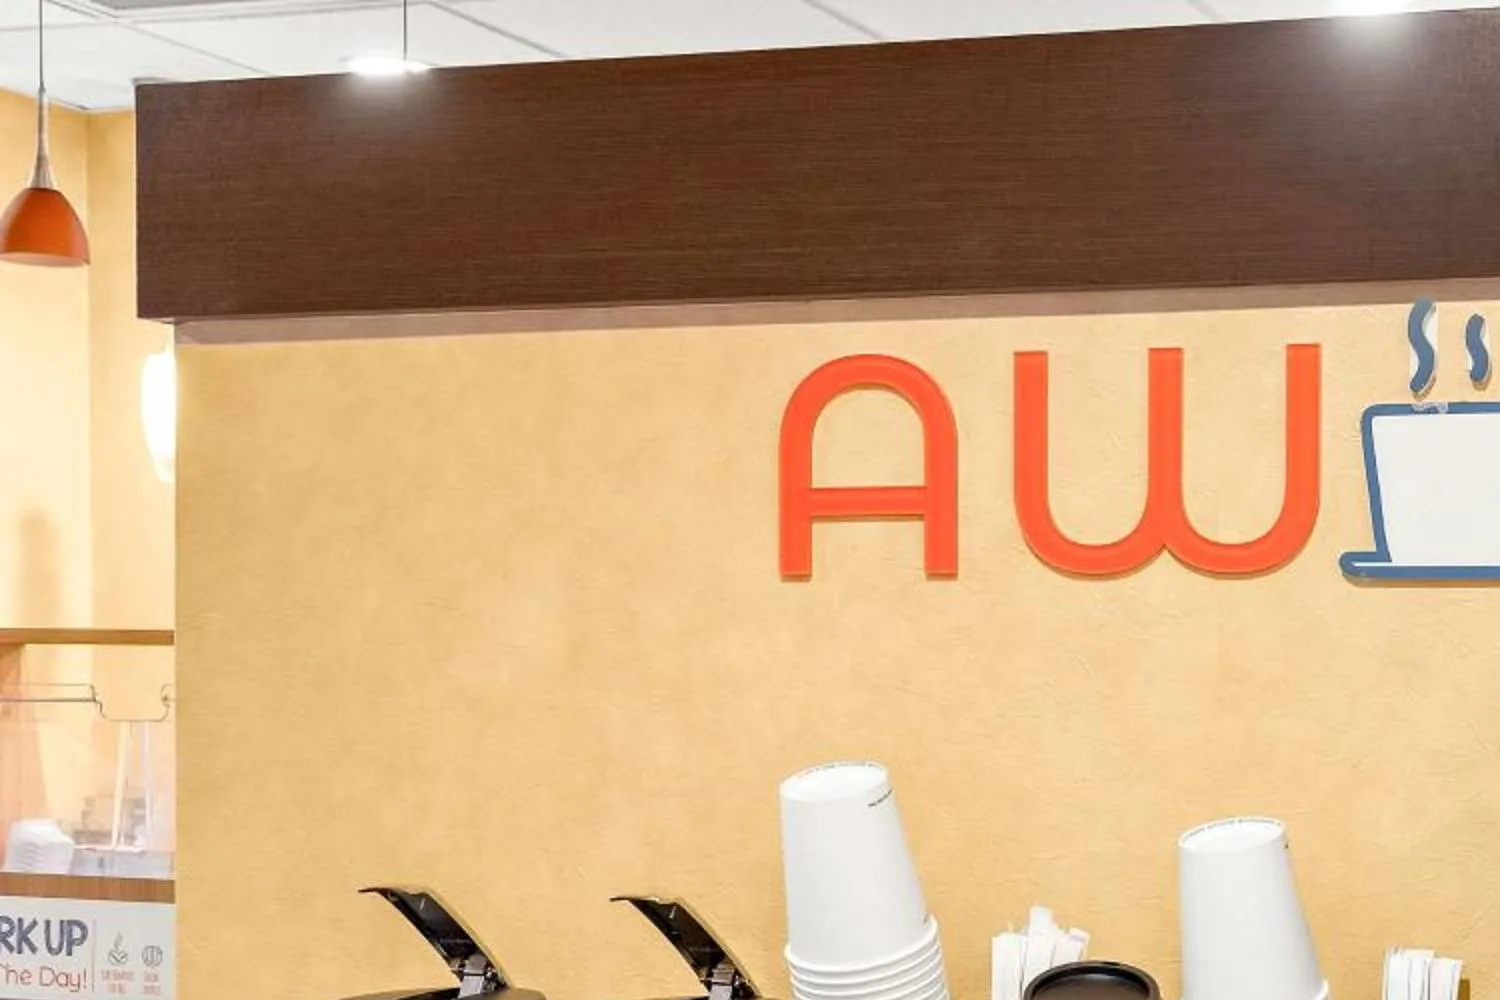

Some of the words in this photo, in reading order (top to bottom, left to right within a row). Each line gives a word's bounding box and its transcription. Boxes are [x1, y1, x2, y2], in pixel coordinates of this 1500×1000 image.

[44, 919, 89, 957] UP
[0, 964, 33, 986] he
[39, 965, 88, 993] Day!
